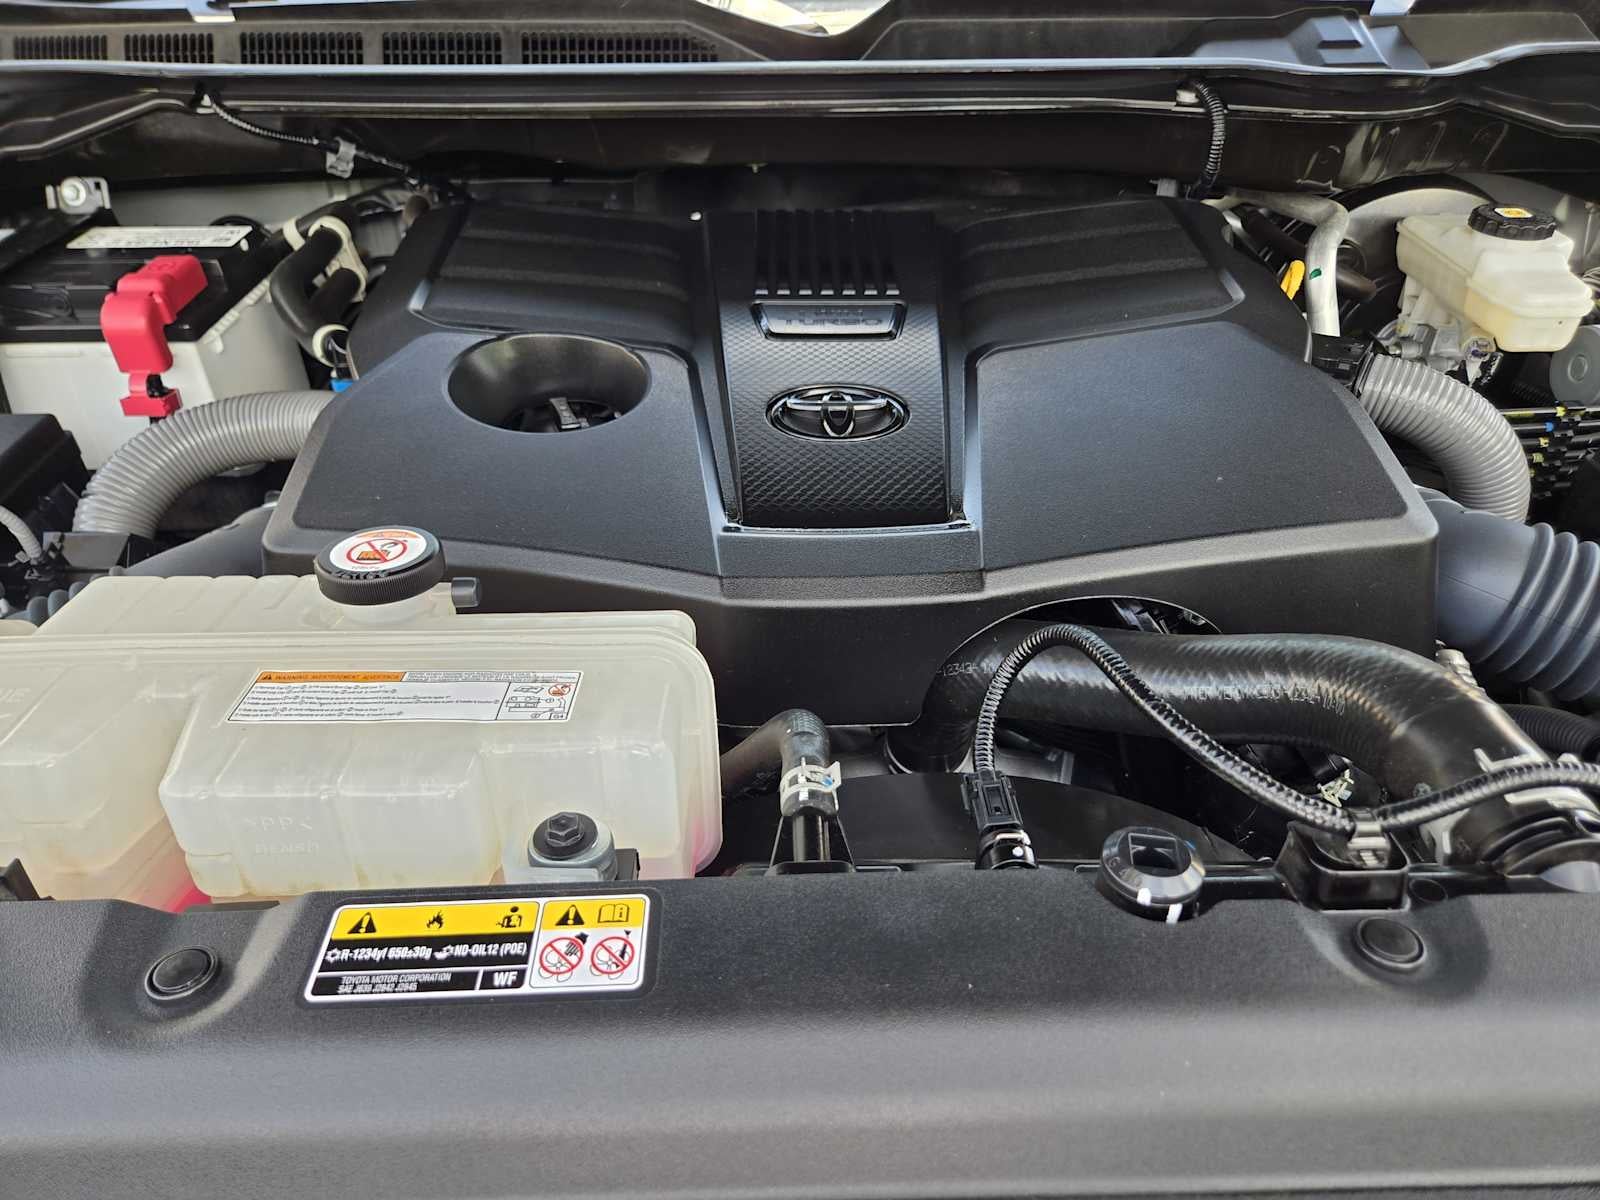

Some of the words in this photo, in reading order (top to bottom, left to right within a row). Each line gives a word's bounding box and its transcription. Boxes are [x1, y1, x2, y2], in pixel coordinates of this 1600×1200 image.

[454, 943, 499, 958] ND-OIL12
[500, 942, 527, 958] (POE)
[341, 975, 370, 985] TOYOTA
[371, 974, 398, 985] MOTOR
[399, 972, 452, 984] CORPORATION
[493, 971, 518, 988] WF
